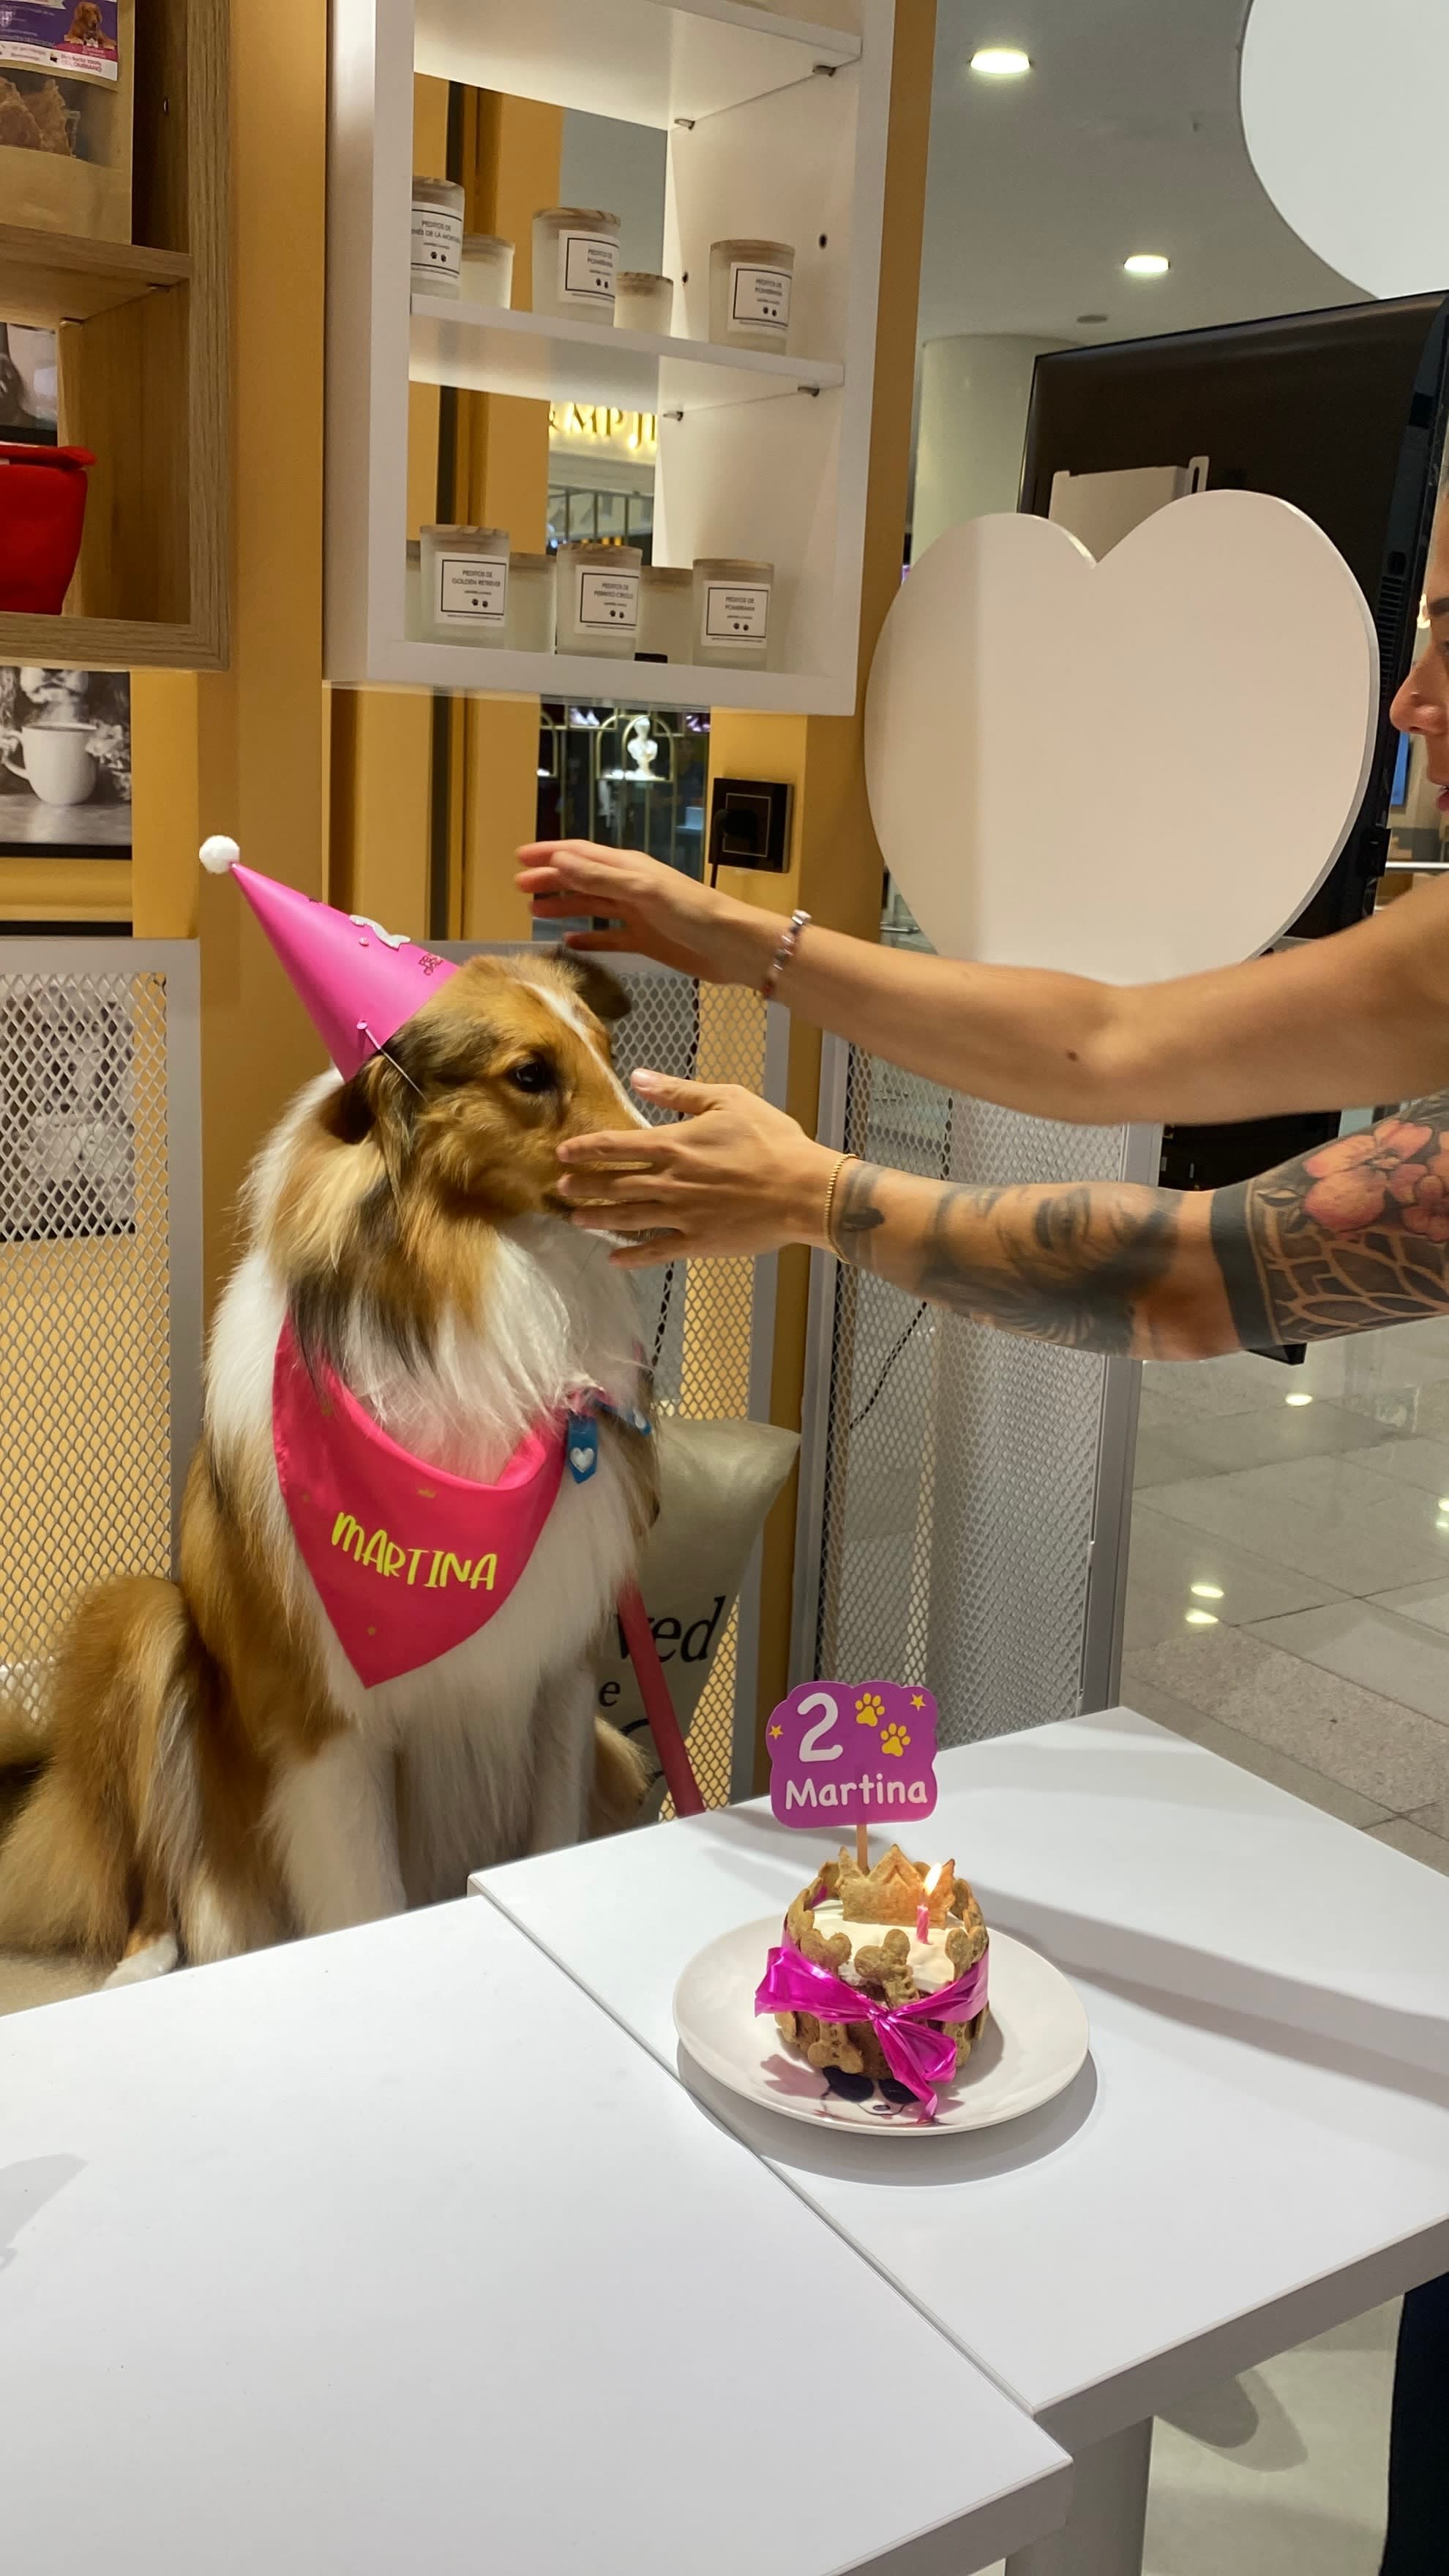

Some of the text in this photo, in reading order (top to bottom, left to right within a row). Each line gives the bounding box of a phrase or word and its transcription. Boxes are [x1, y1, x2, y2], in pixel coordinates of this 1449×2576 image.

[445, 224, 452, 232] DE
[452, 577, 477, 585] GOLDEN
[331, 1511, 498, 1591] MARTINA
[797, 1692, 844, 1763] 2
[785, 1772, 928, 1811] Martina
